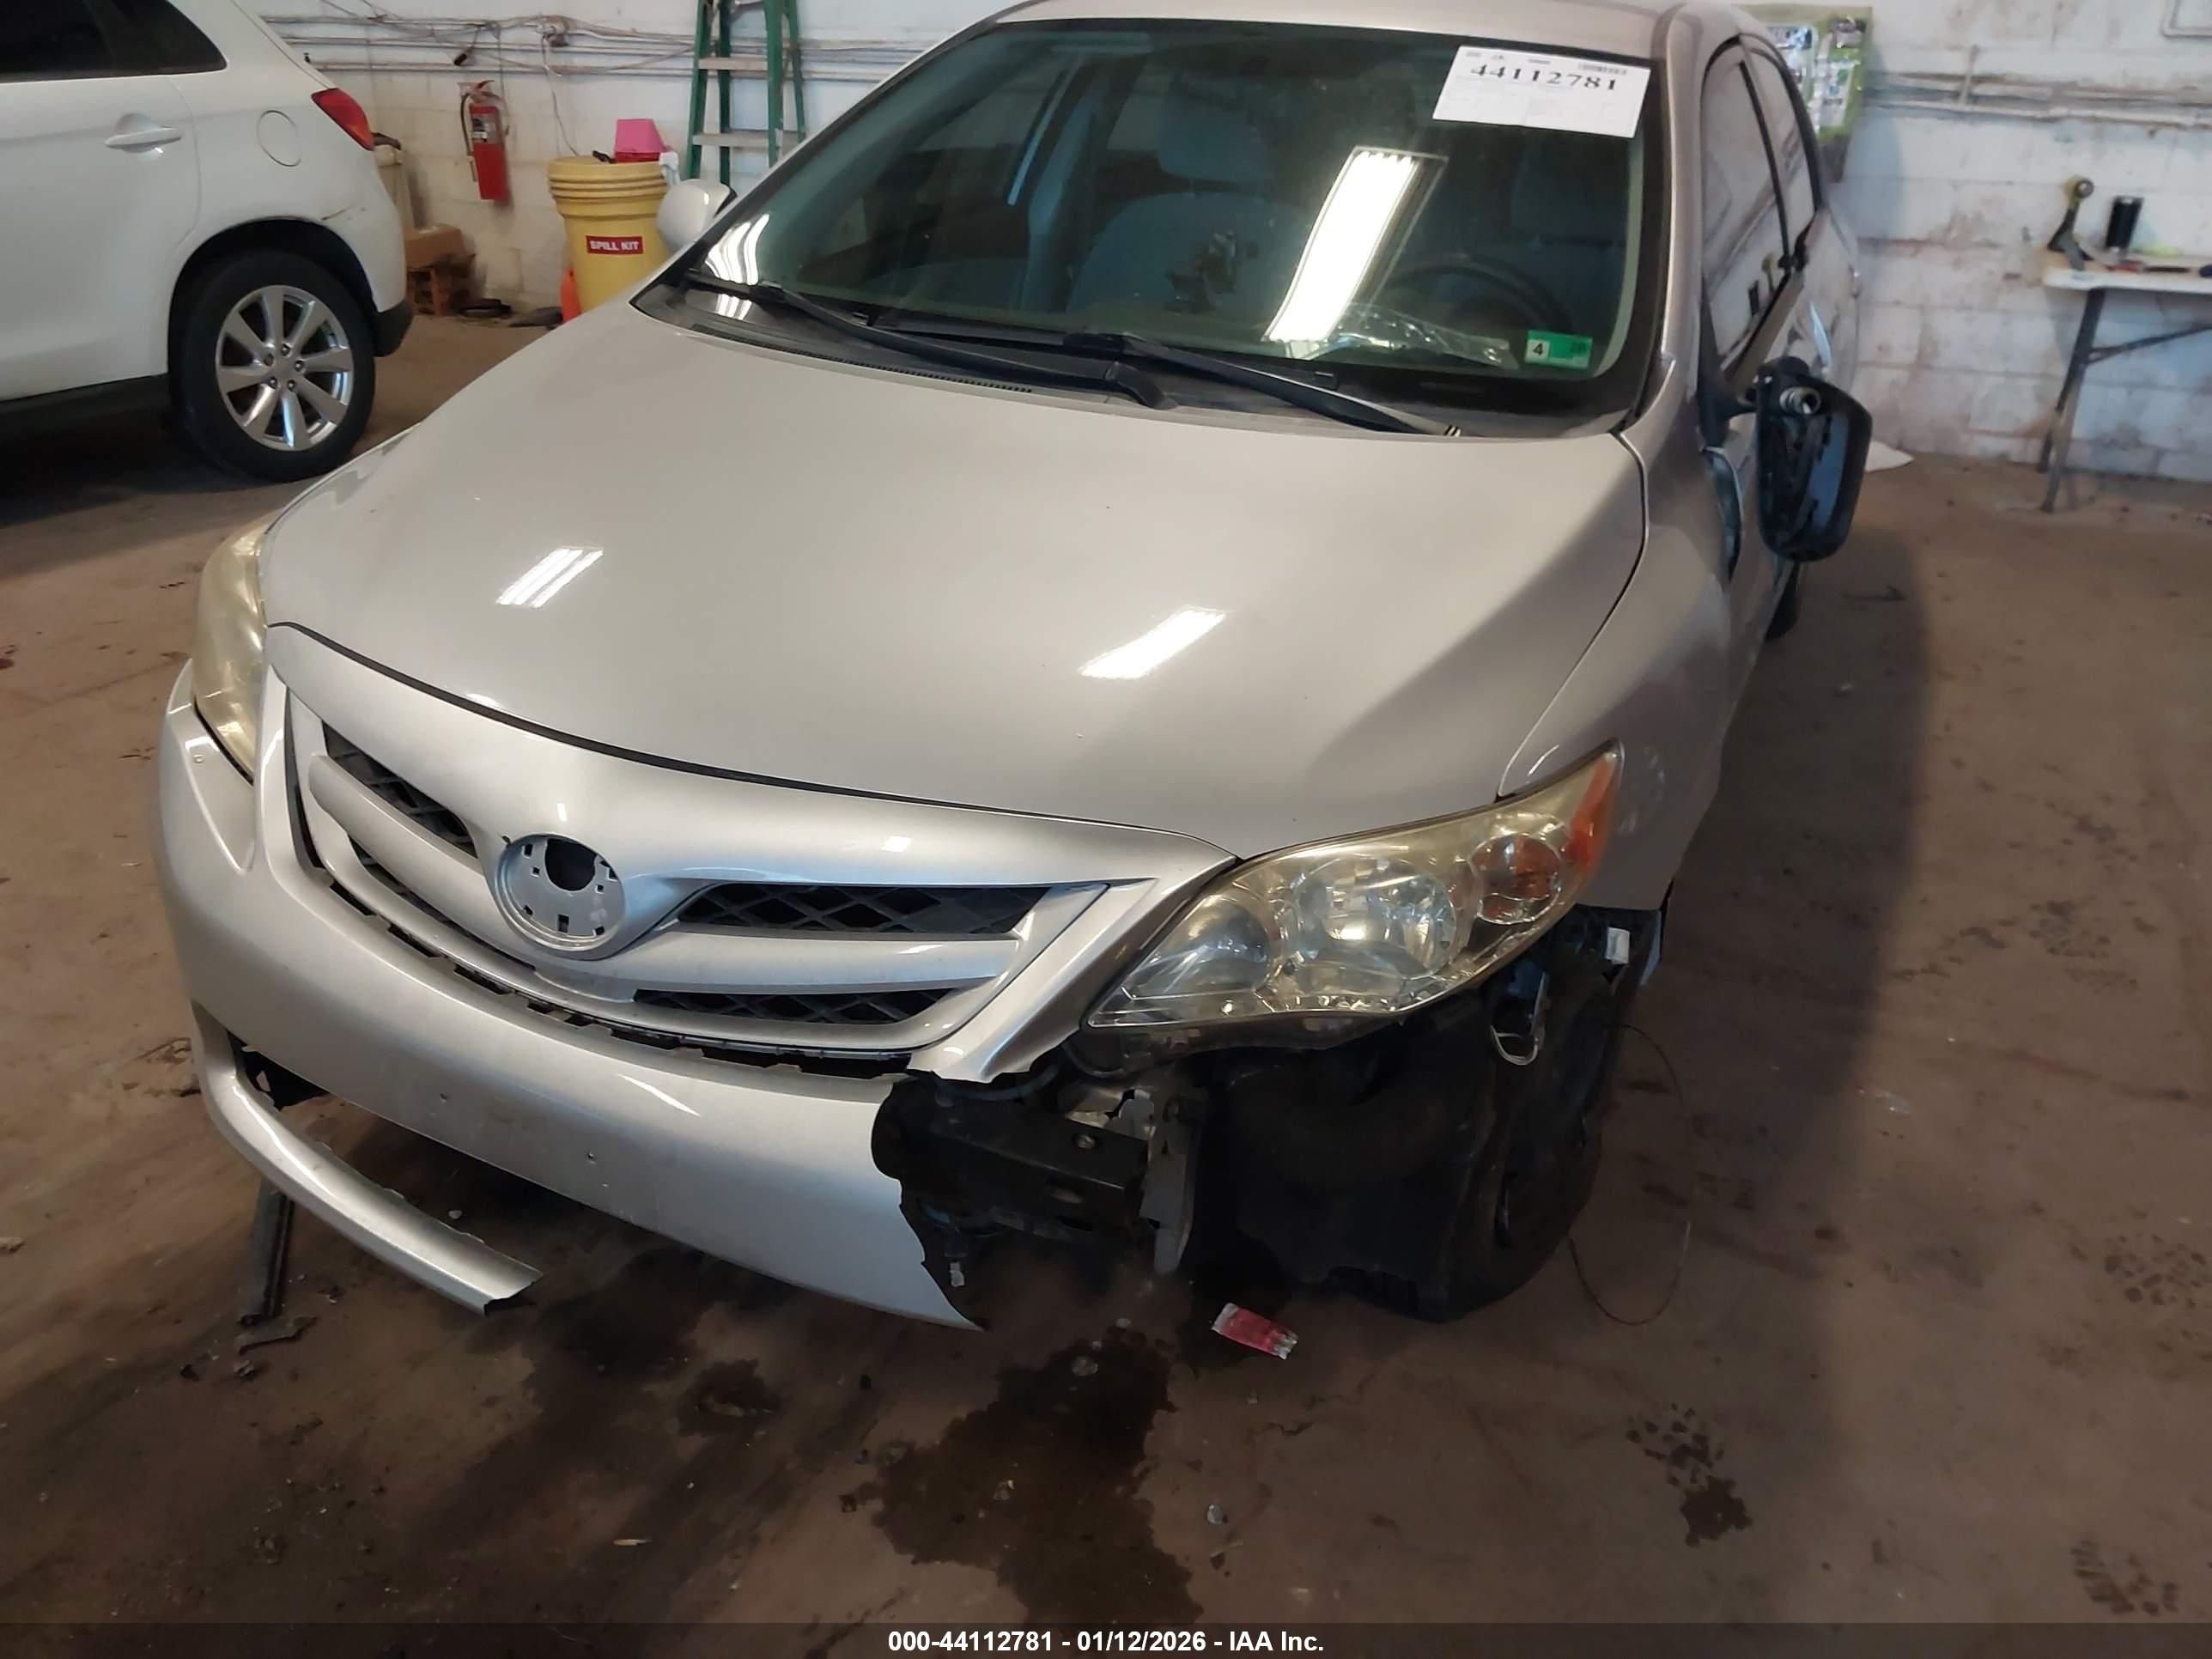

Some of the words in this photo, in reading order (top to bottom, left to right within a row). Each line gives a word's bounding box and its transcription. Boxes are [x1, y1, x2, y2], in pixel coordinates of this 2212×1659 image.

[1470, 64, 1616, 91] 44112781
[590, 240, 619, 251] SPILL
[621, 240, 640, 251] KIT
[1532, 343, 1544, 356] 4
